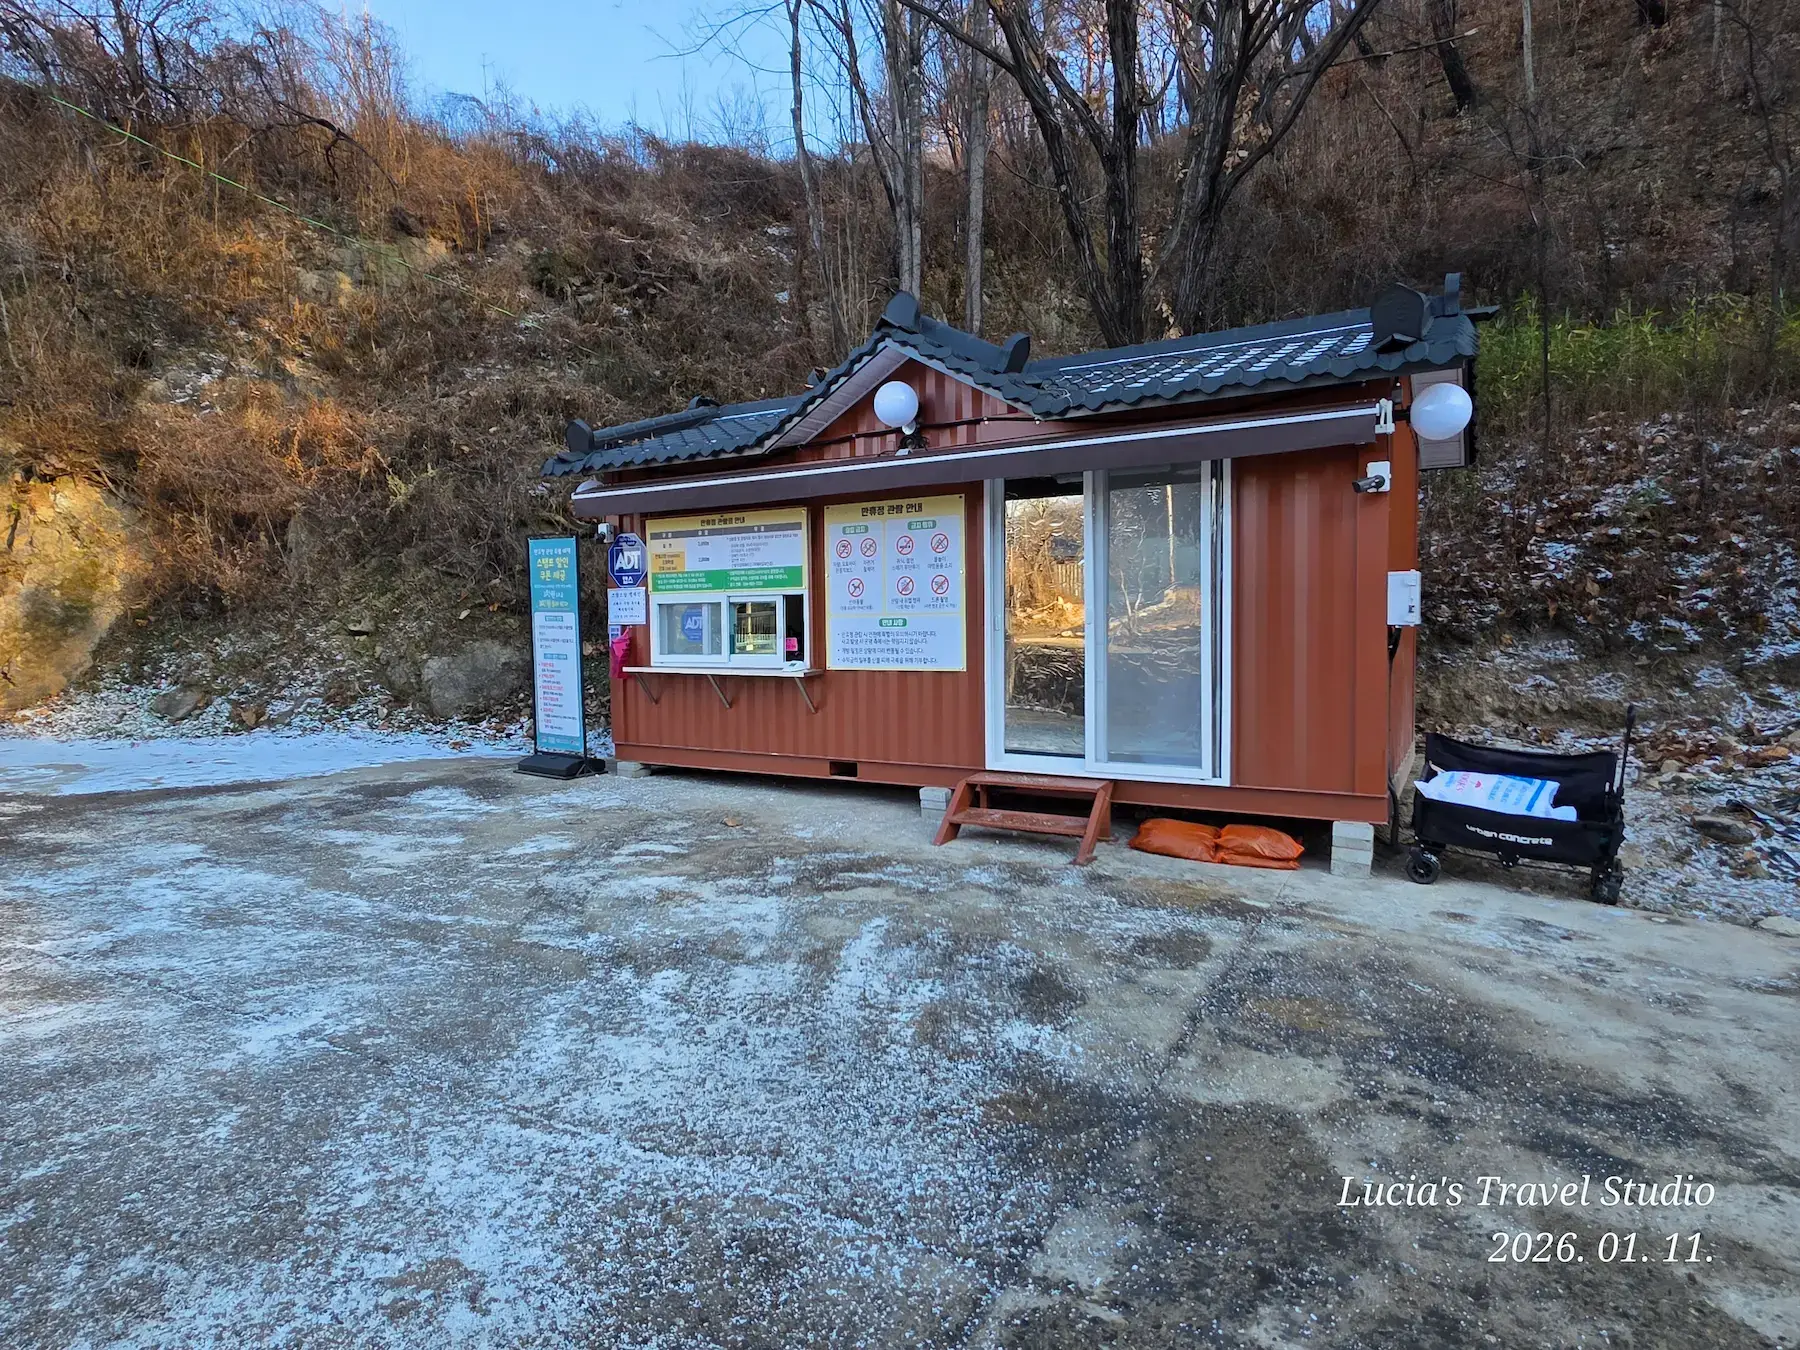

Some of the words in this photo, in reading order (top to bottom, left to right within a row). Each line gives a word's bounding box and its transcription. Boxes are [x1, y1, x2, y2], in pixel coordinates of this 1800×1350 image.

[861, 506, 884, 516] 만휴정
[887, 504, 904, 514] 관람
[906, 502, 922, 513] 안내
[536, 557, 554, 568] 스탬프
[556, 556, 568, 568] 할인
[614, 551, 640, 570] ADT
[540, 570, 552, 581] 쿠폰
[1466, 824, 1498, 838] urban
[1498, 832, 1553, 846] concrete
